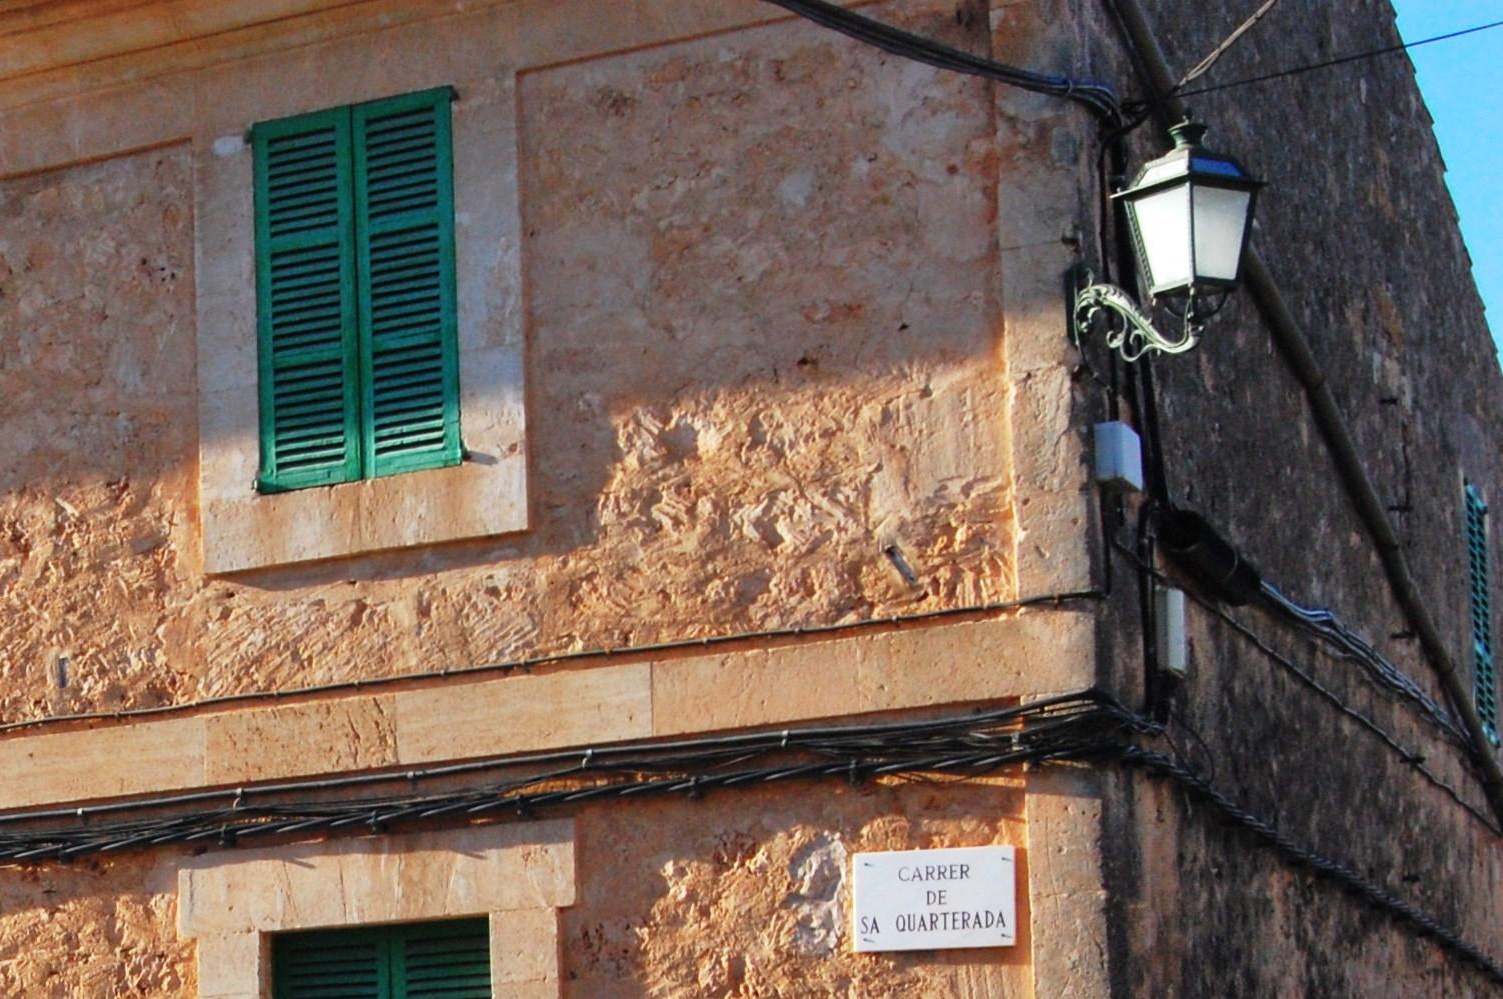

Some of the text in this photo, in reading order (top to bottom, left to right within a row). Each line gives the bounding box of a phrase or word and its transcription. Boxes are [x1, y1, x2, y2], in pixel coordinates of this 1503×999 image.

[898, 864, 970, 882] CARRER
[926, 890, 947, 906] DE
[861, 910, 1006, 934] SA QUARTERADA
